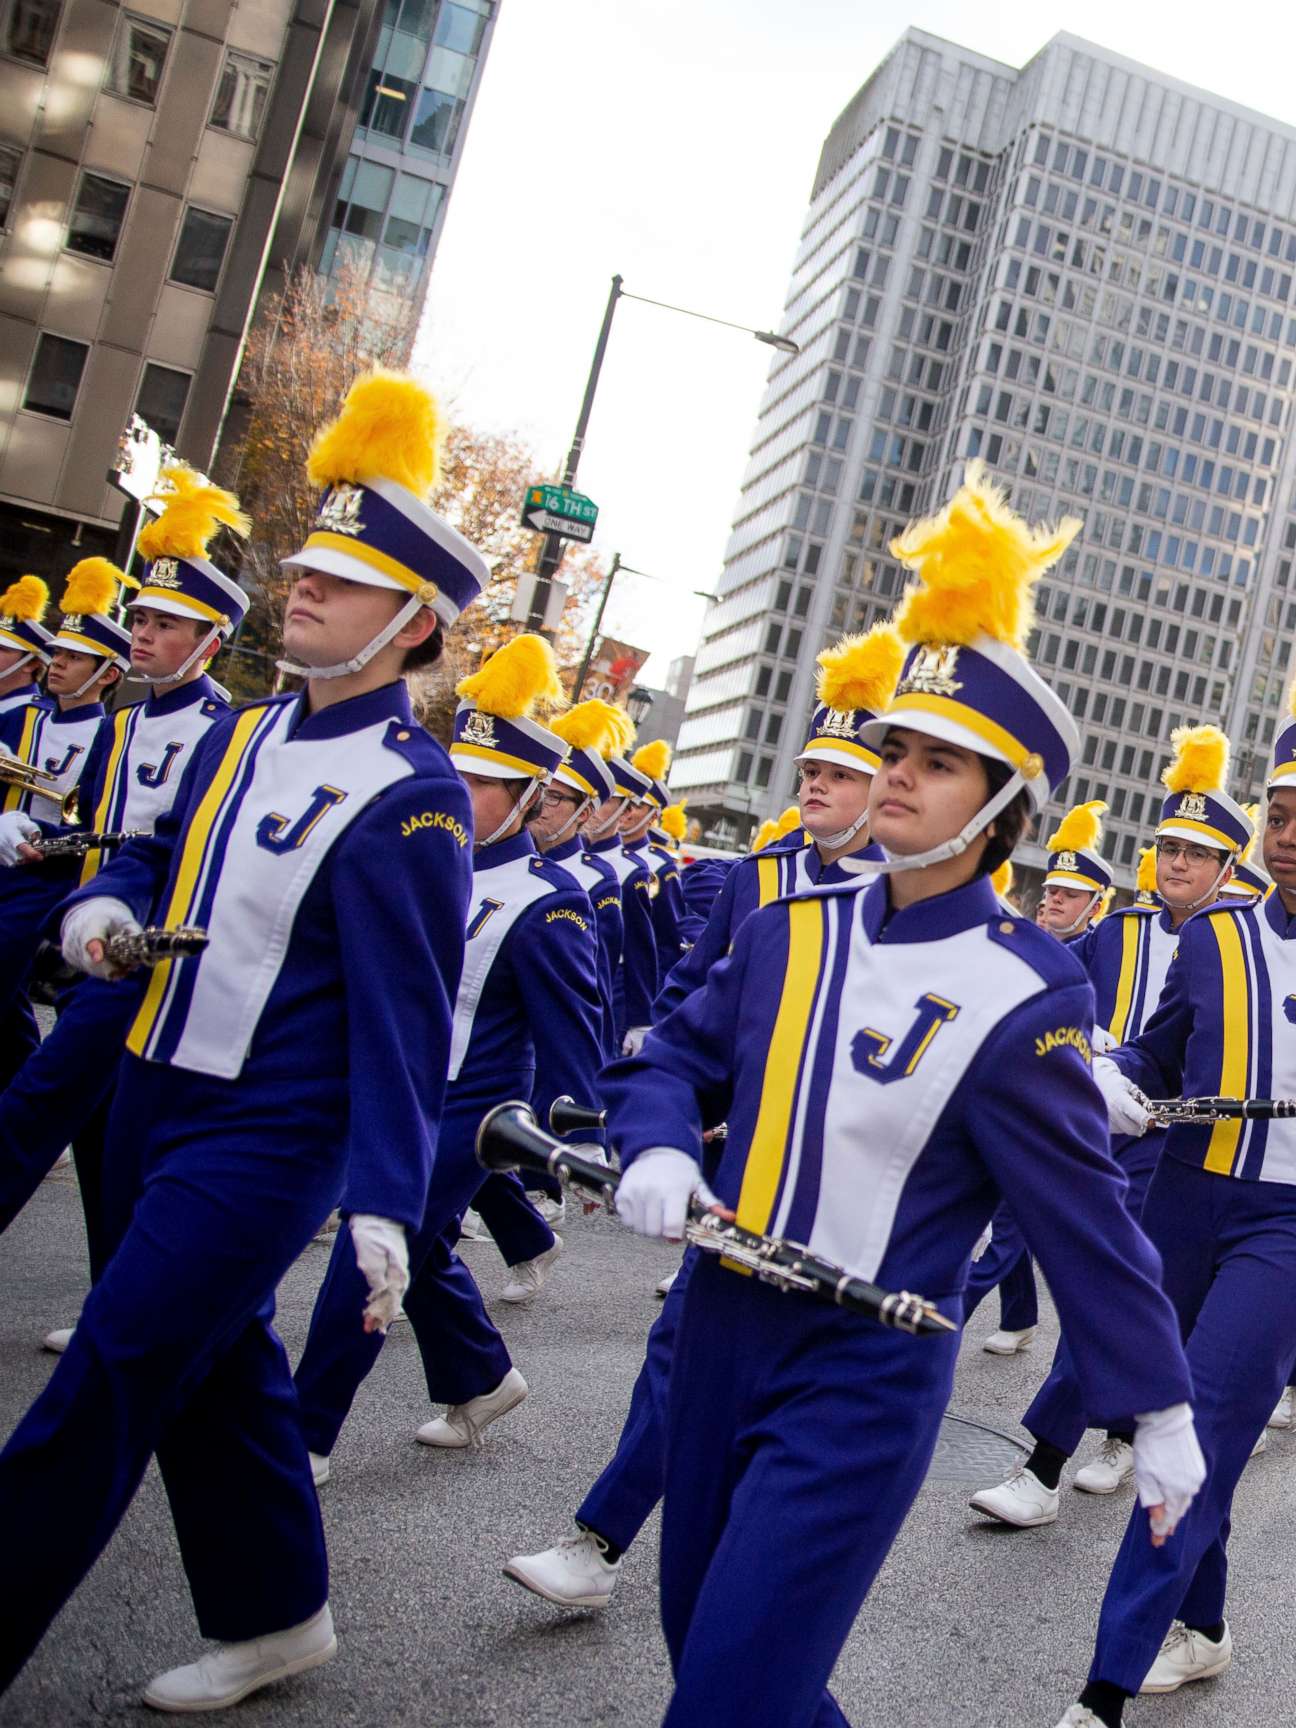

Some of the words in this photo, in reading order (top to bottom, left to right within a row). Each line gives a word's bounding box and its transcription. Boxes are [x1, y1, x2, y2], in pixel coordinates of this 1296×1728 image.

[544, 493, 560, 510] 16
[563, 498, 582, 516] TH
[583, 505, 597, 519] ST
[544, 517, 561, 530] ONE
[567, 521, 587, 535] WAY
[584, 677, 615, 701] 30
[45, 743, 85, 776] J
[136, 741, 185, 789] J
[256, 784, 349, 856] J
[401, 812, 468, 848] JACKSON
[545, 908, 588, 931] JACKSON
[850, 992, 961, 1085] J
[1035, 1026, 1092, 1065] JACKSON
